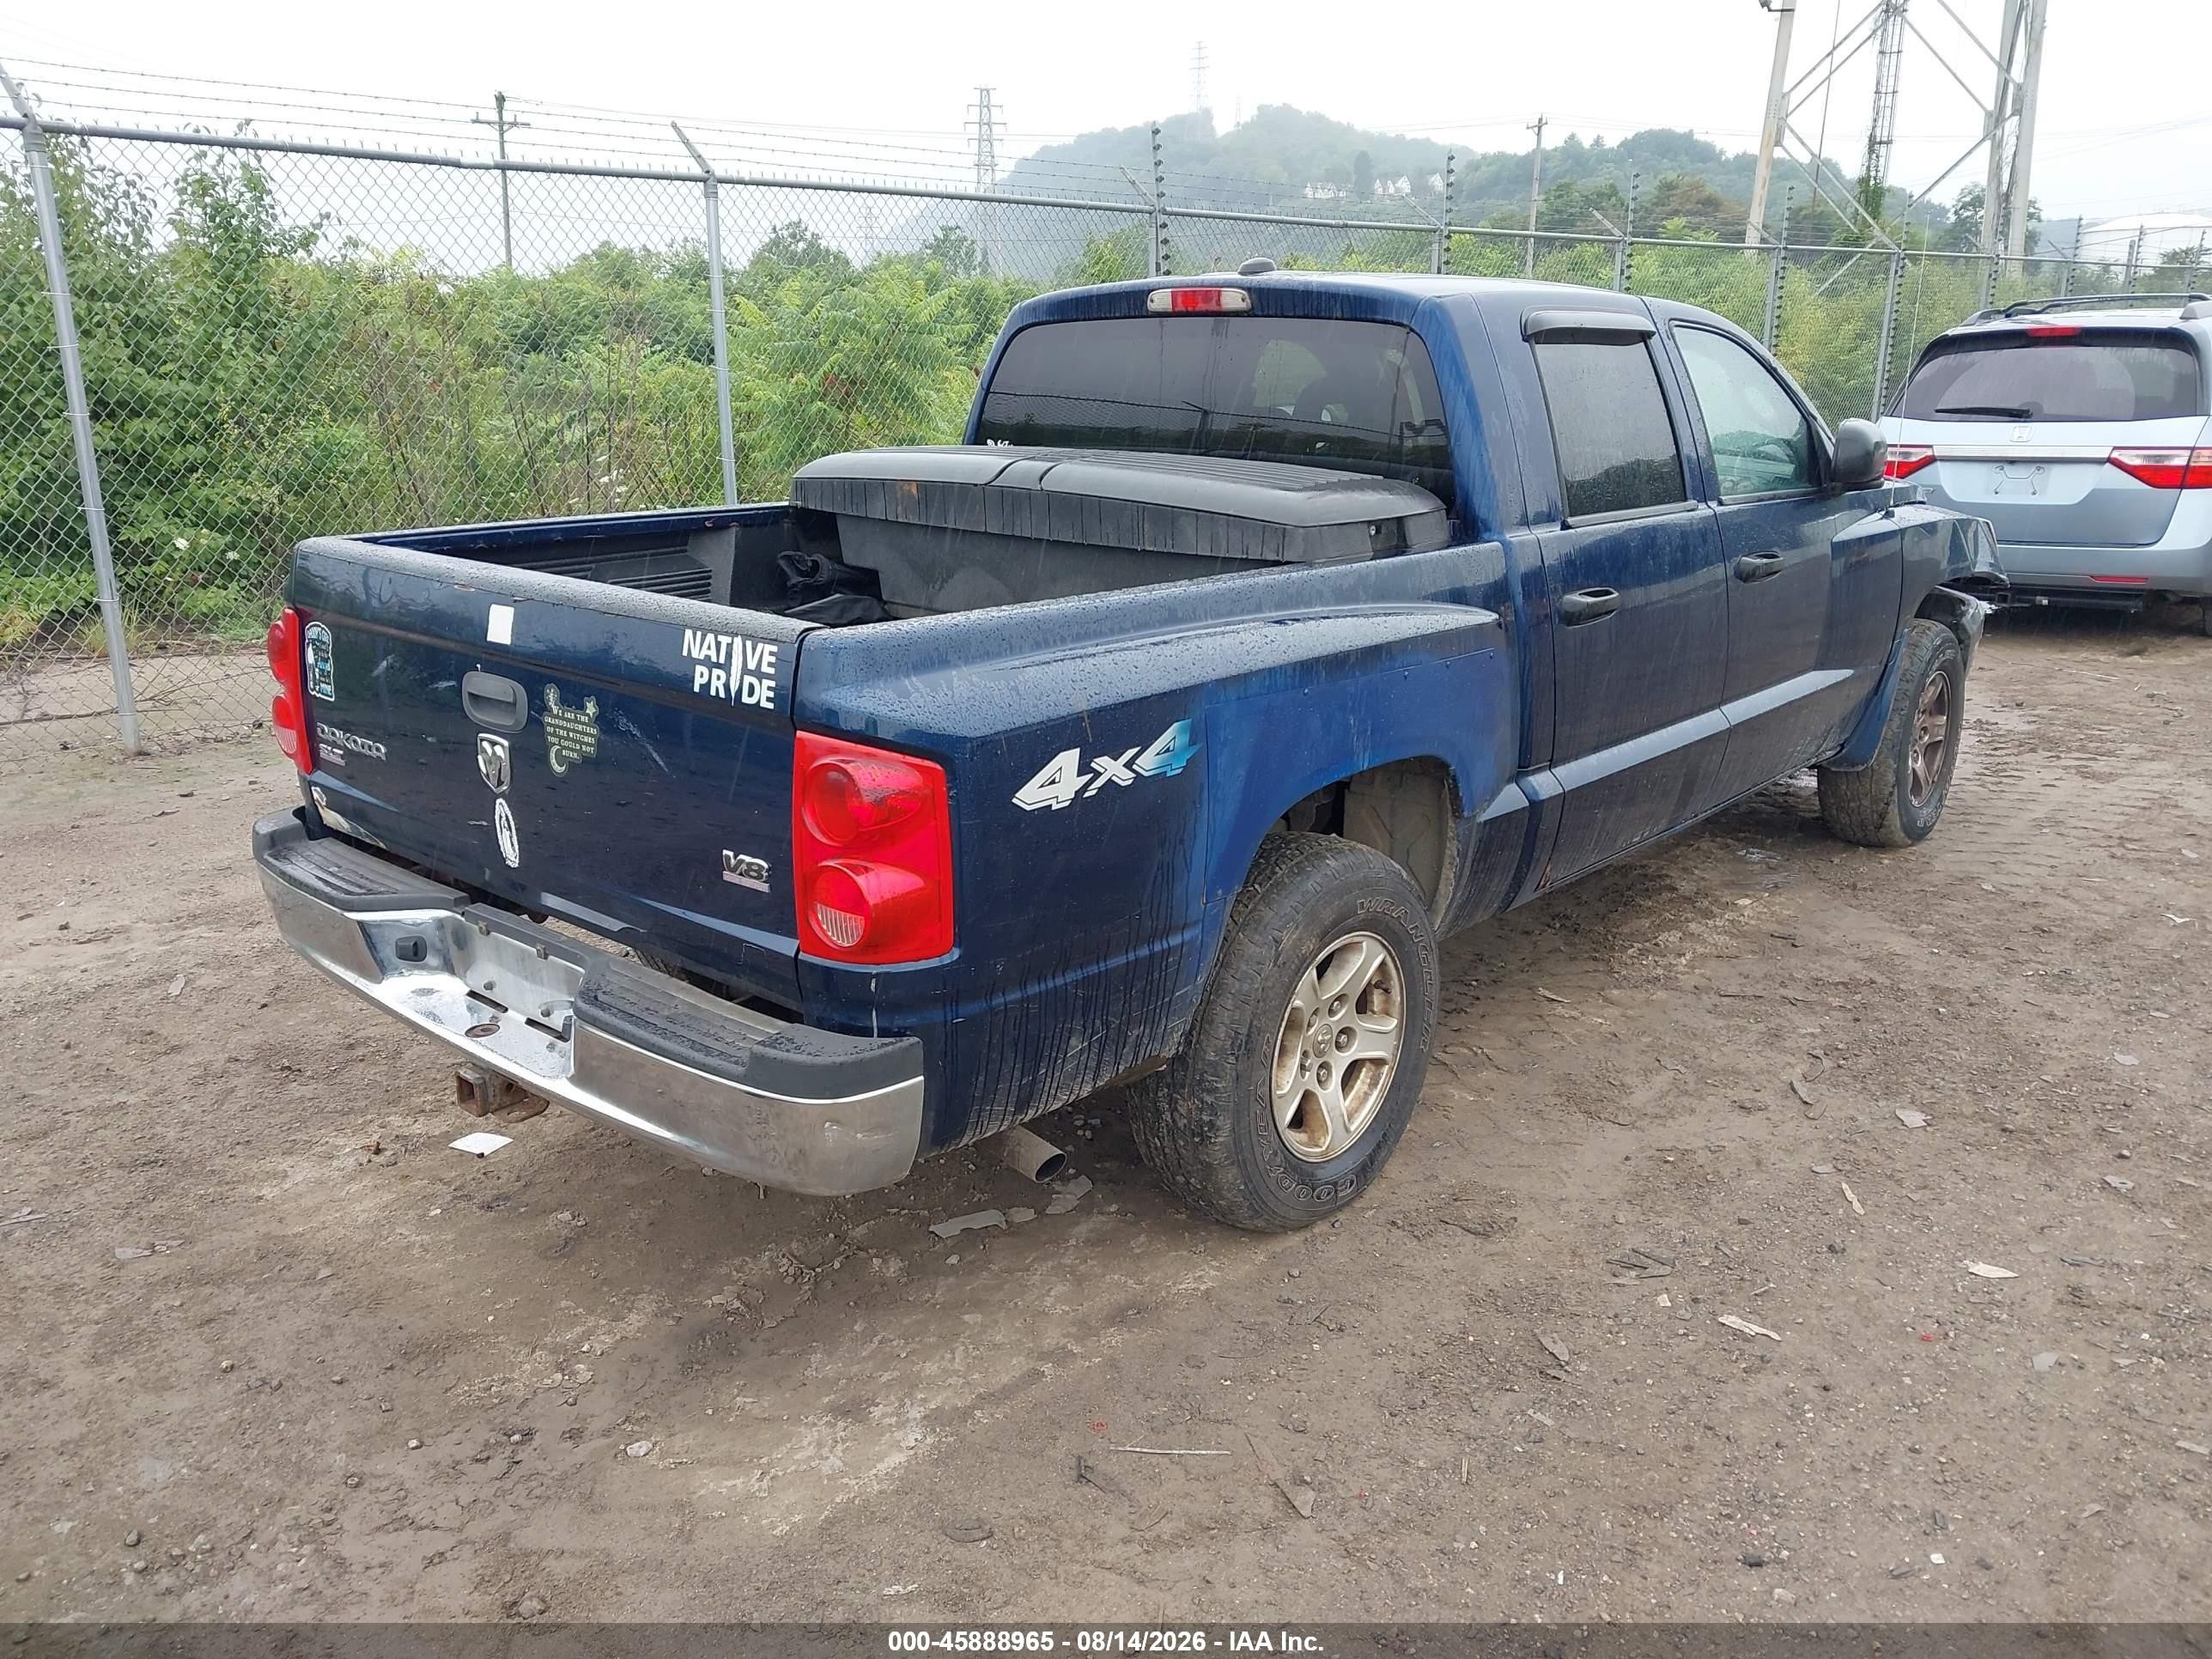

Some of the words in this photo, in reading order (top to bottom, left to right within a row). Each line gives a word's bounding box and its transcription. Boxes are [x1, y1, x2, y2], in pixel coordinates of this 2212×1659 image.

[683, 629, 778, 674] NATIVE
[693, 665, 776, 709] PRIDE
[544, 715, 597, 735] GRANDDAUGHTERS
[564, 711, 575, 720] ARE
[576, 714, 589, 723] THE
[317, 722, 386, 762] DAKOTA
[546, 726, 555, 734] OF
[556, 727, 568, 737] THE
[568, 732, 595, 744] WITCHES
[547, 736, 559, 744] YOU
[560, 739, 580, 750] COULD
[581, 744, 595, 754] NOT
[723, 849, 769, 883] V8
[1357, 896, 1436, 1054] WRANGLER
